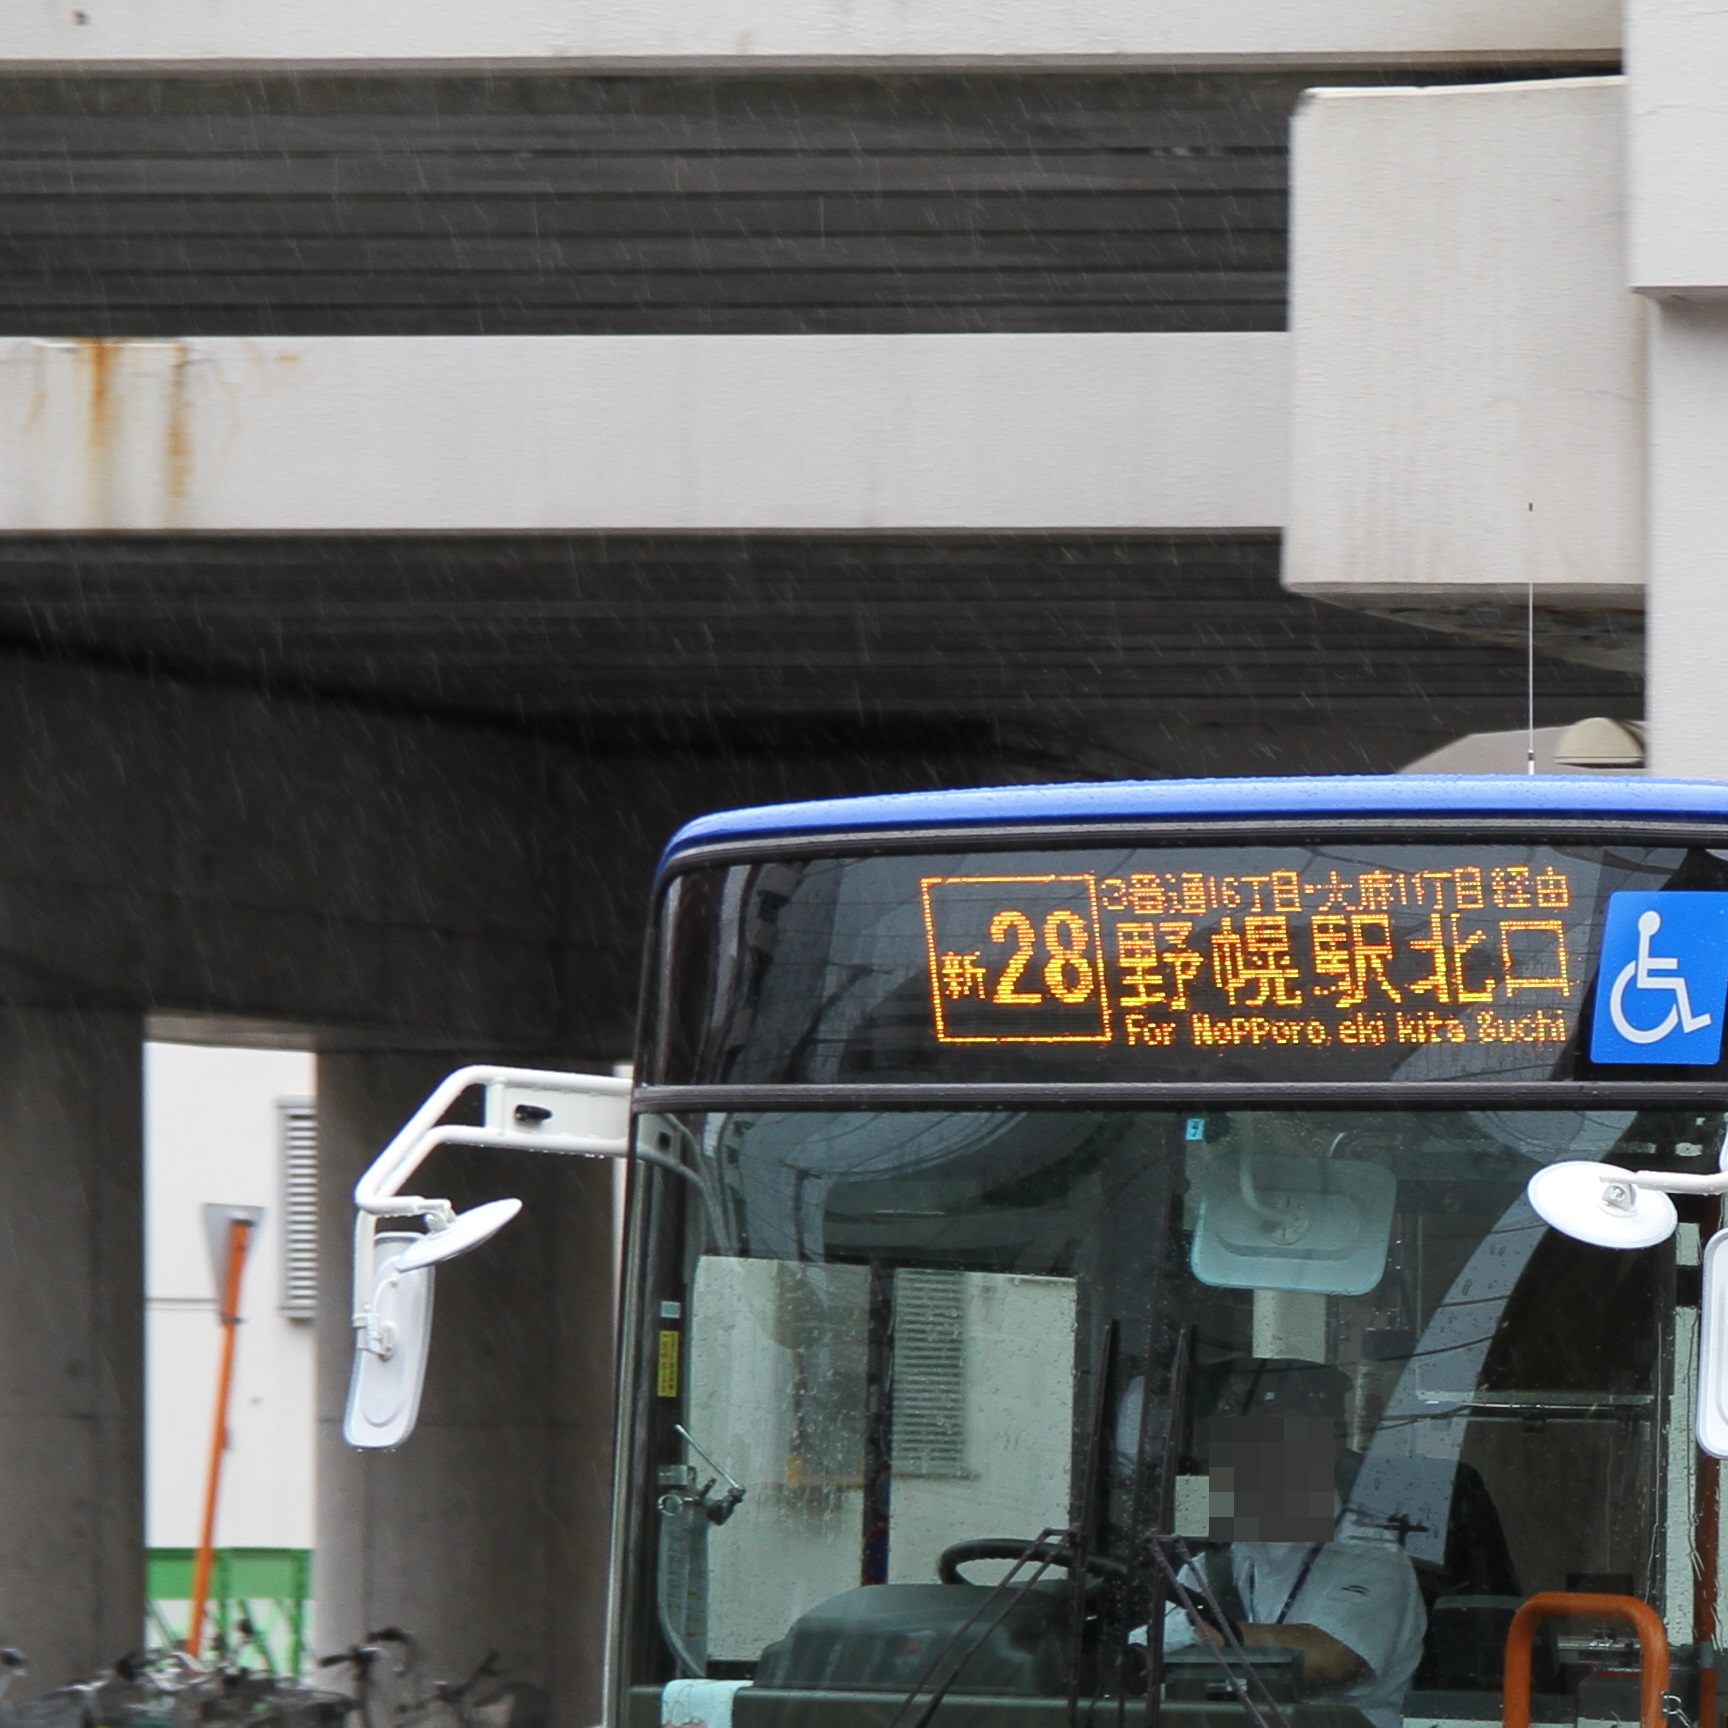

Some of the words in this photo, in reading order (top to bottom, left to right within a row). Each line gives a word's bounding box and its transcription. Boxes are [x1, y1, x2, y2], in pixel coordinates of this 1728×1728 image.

[989, 910, 1094, 1004] 28
[1115, 912, 1571, 1010] 野幌駅北口
[1124, 1013, 1176, 1046] For
